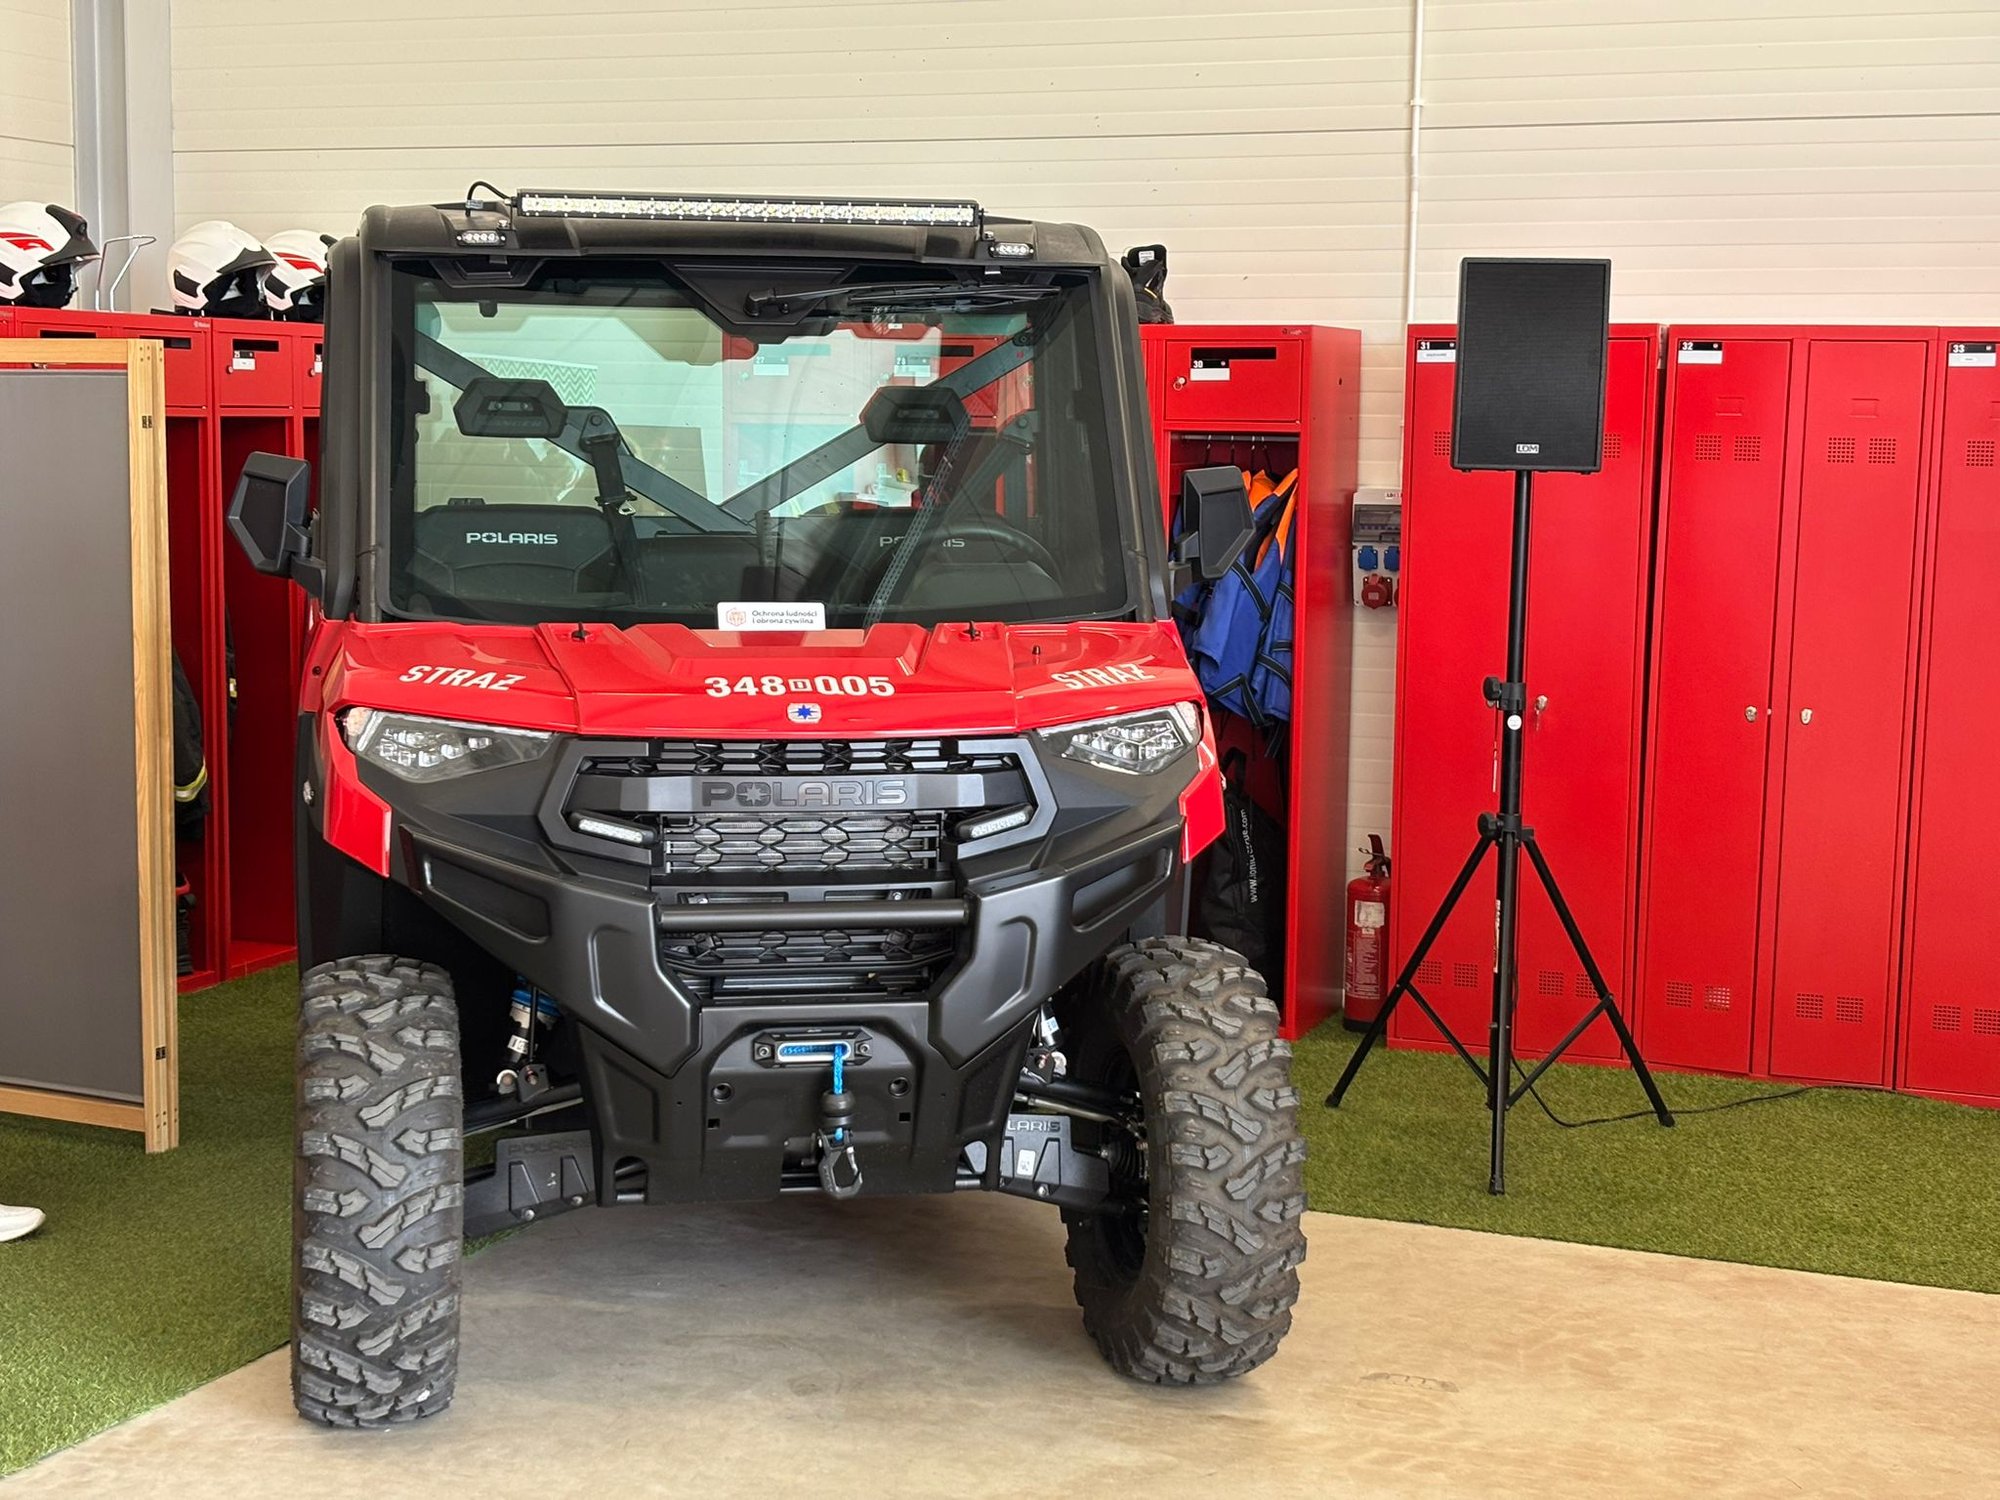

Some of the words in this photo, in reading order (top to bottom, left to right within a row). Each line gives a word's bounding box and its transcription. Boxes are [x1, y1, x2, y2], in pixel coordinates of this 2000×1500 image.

[1420, 341, 1430, 350] 31
[1682, 341, 1694, 351] 32
[1952, 344, 1965, 353] 33
[1193, 360, 1204, 369] 30
[466, 532, 558, 545] POLARIS
[752, 609, 785, 617] Ochrona
[786, 609, 818, 617] ludności
[784, 617, 814, 625] cywilna
[702, 780, 908, 807] POLARIS
[1007, 1120, 1060, 1132] LARIS
